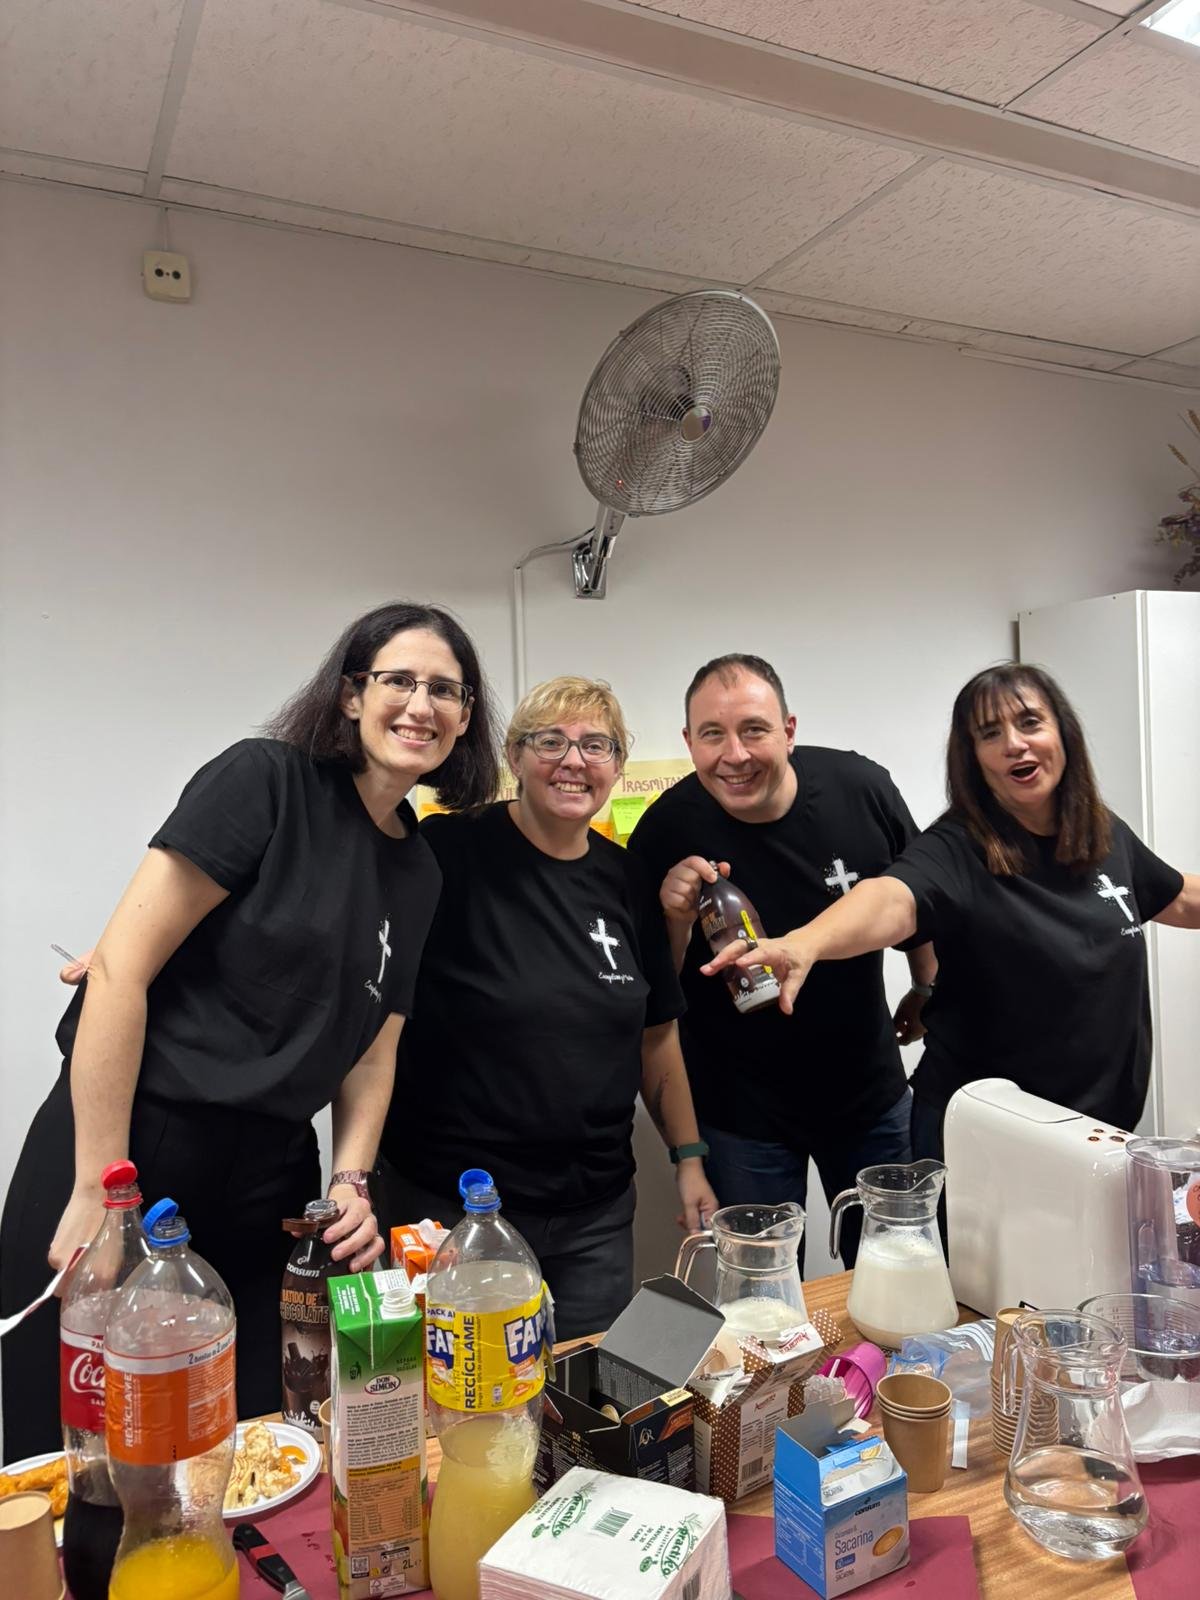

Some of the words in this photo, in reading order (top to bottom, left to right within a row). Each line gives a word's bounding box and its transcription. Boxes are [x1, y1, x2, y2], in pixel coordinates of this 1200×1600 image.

[286, 1262, 320, 1278] consum
[306, 1292, 318, 1306] DE
[462, 1316, 476, 1409] RECÍCLAME
[376, 1376, 390, 1384] DON
[854, 1501, 881, 1516] consum
[834, 1529, 874, 1556] Sacarina
[661, 1526, 688, 1576] practiko
